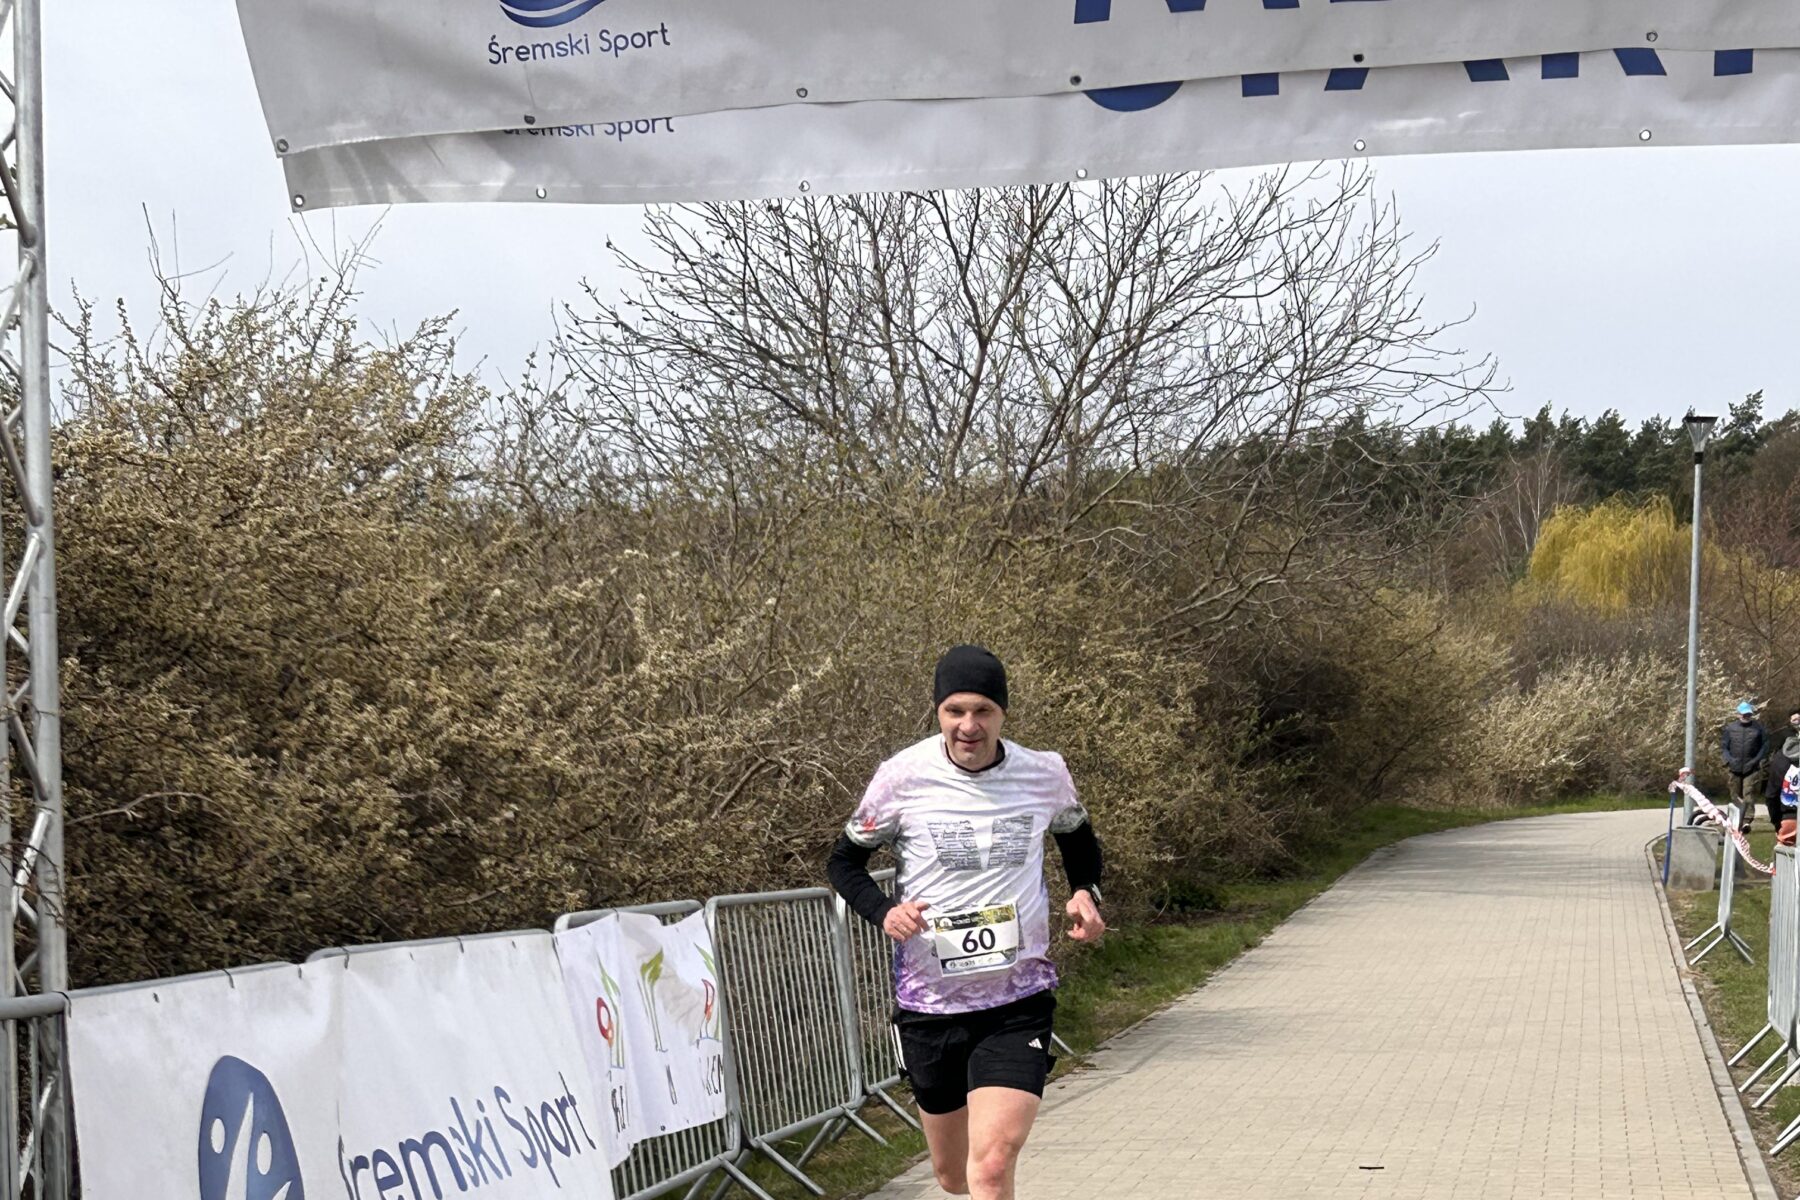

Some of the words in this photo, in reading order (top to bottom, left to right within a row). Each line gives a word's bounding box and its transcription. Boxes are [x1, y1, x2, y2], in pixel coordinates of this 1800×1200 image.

[488, 33, 590, 65] Śremski
[599, 22, 671, 58] Sport
[962, 927, 996, 954] 60
